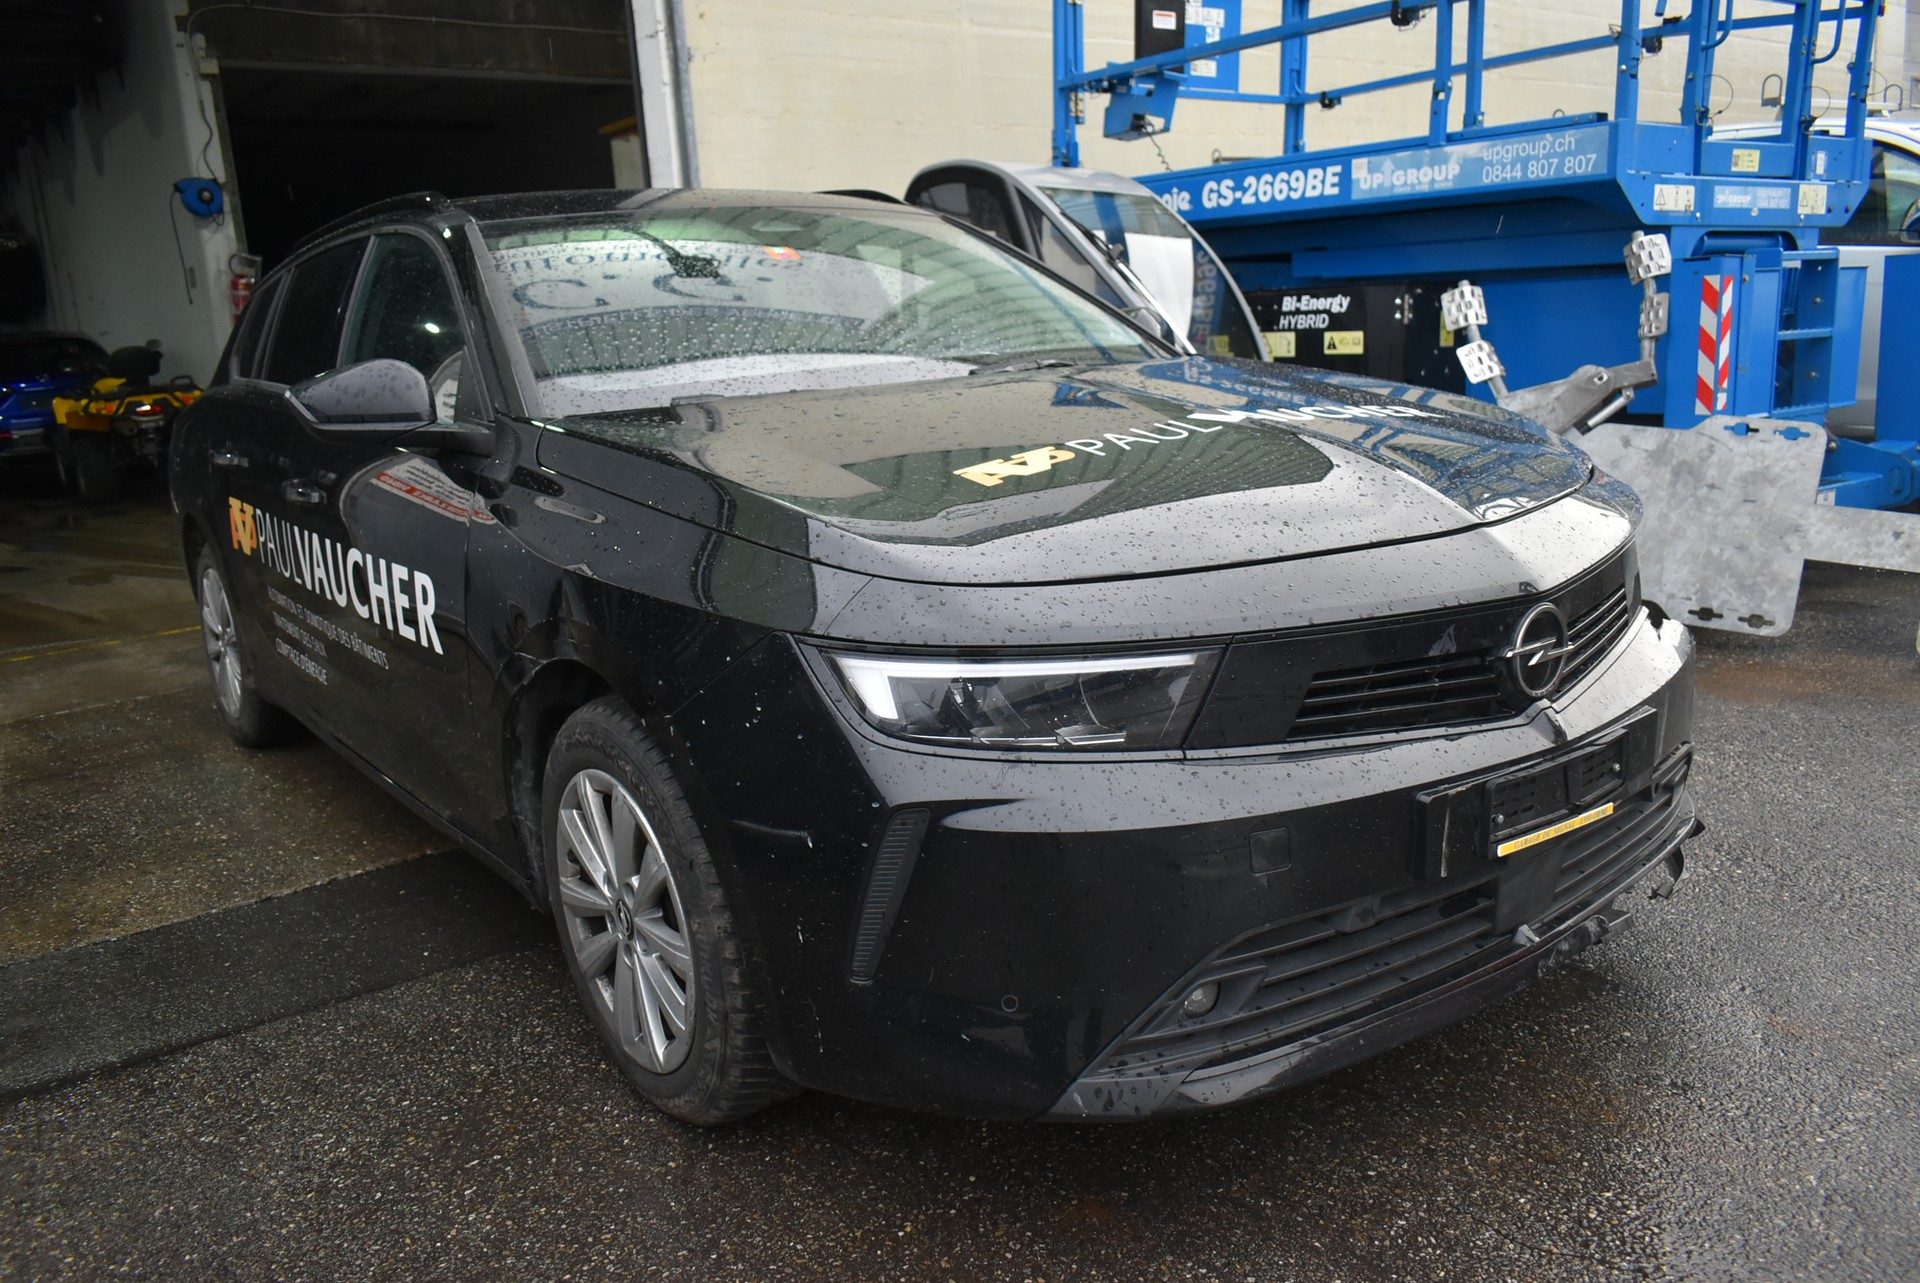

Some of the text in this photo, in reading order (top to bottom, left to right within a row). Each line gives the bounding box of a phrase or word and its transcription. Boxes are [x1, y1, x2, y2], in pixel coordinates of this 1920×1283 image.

[1482, 133, 1576, 163] upgroup.ch
[1482, 153, 1598, 184] 0844 807 807
[1201, 164, 1343, 209] GS-2669BE
[1281, 294, 1351, 313] Bi-Energy
[1279, 313, 1330, 330] HYBRID
[1513, 833, 1540, 850] GARAGE
